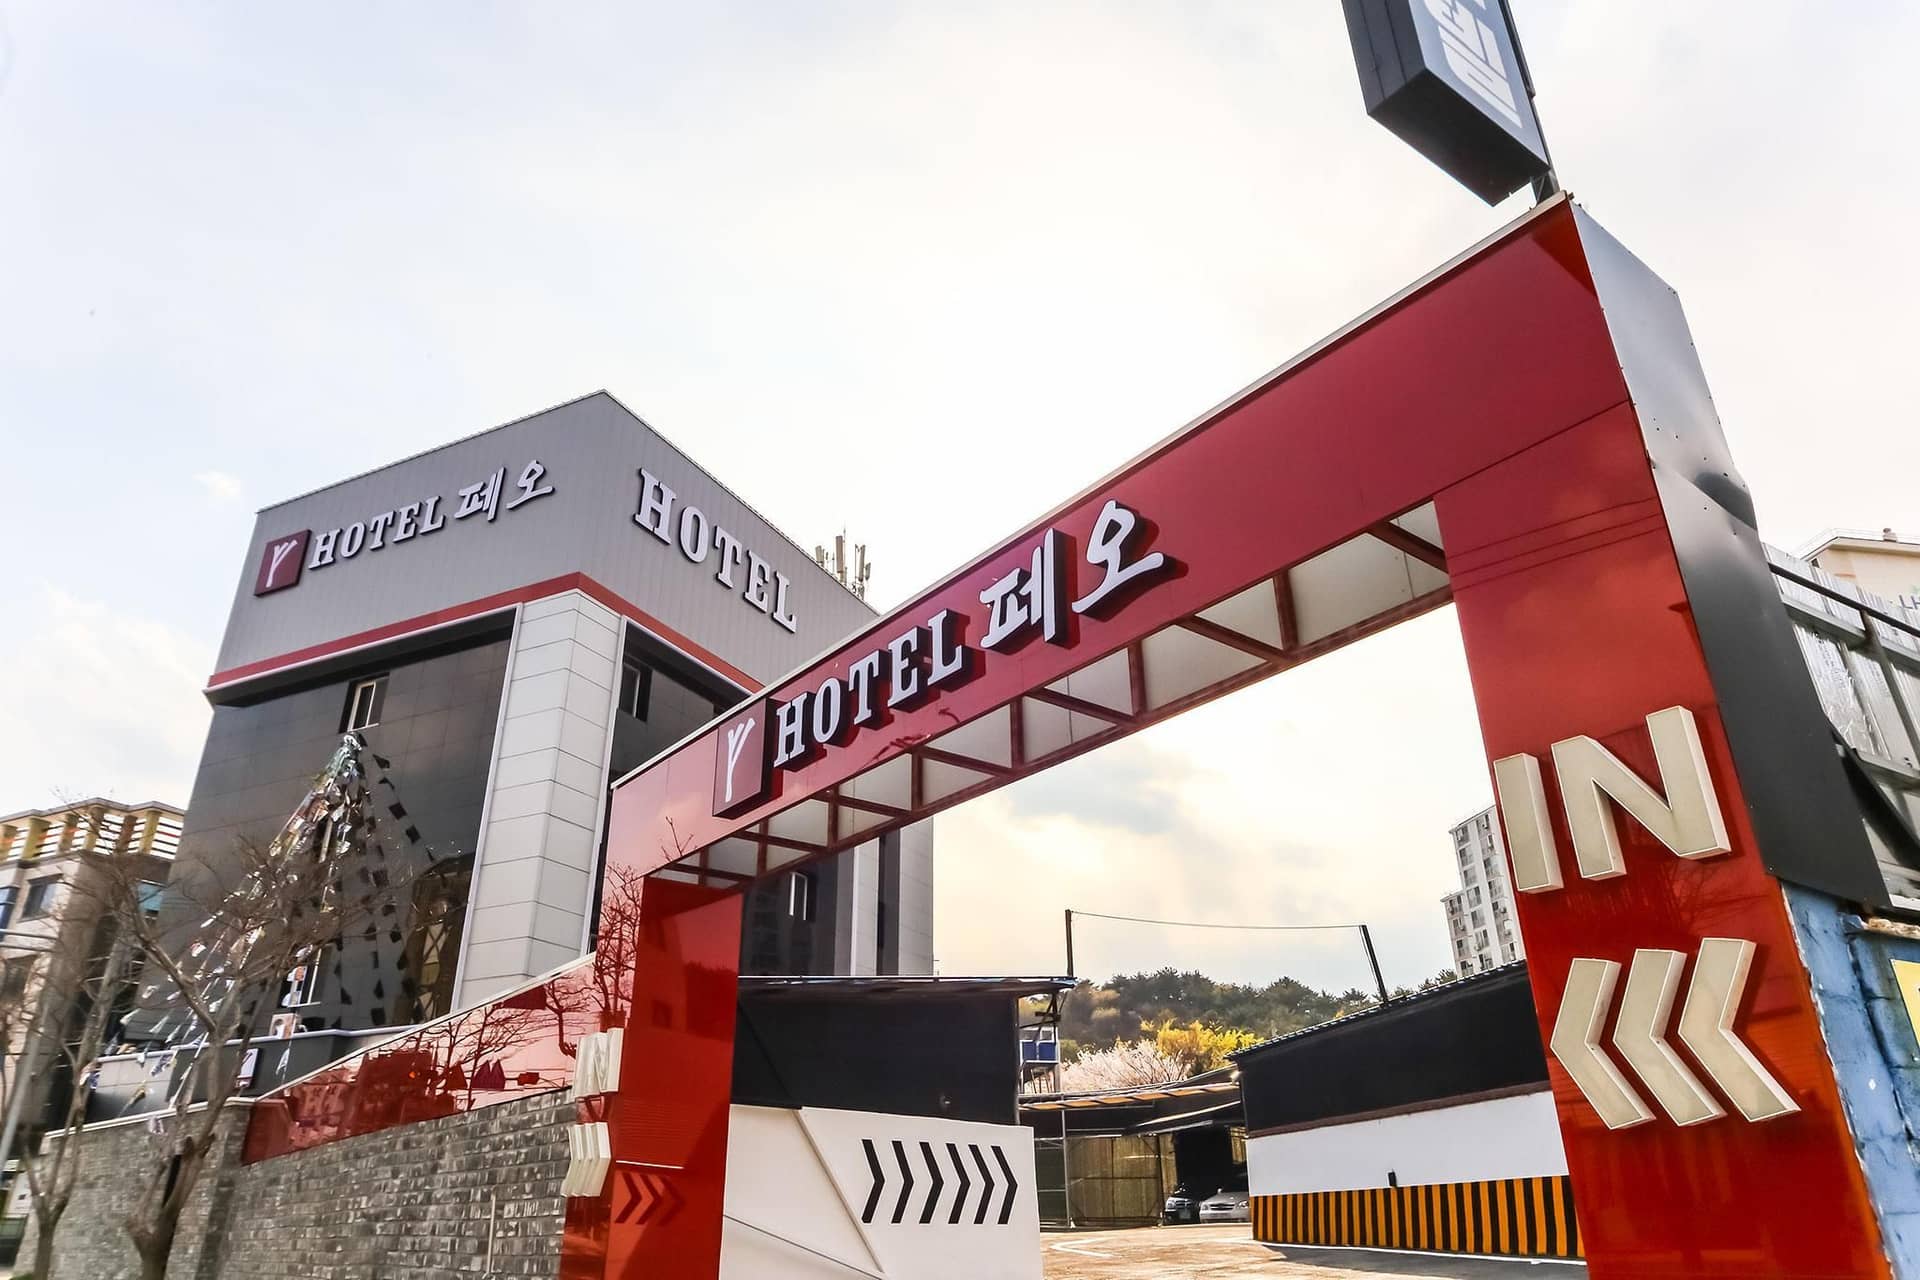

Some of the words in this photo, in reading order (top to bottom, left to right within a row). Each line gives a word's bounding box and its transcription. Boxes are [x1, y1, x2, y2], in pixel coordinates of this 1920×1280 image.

[308, 496, 446, 569] HOTEL
[633, 467, 798, 633] HOTEL
[773, 608, 965, 769] HOTEL
[1494, 706, 1731, 893] IN
